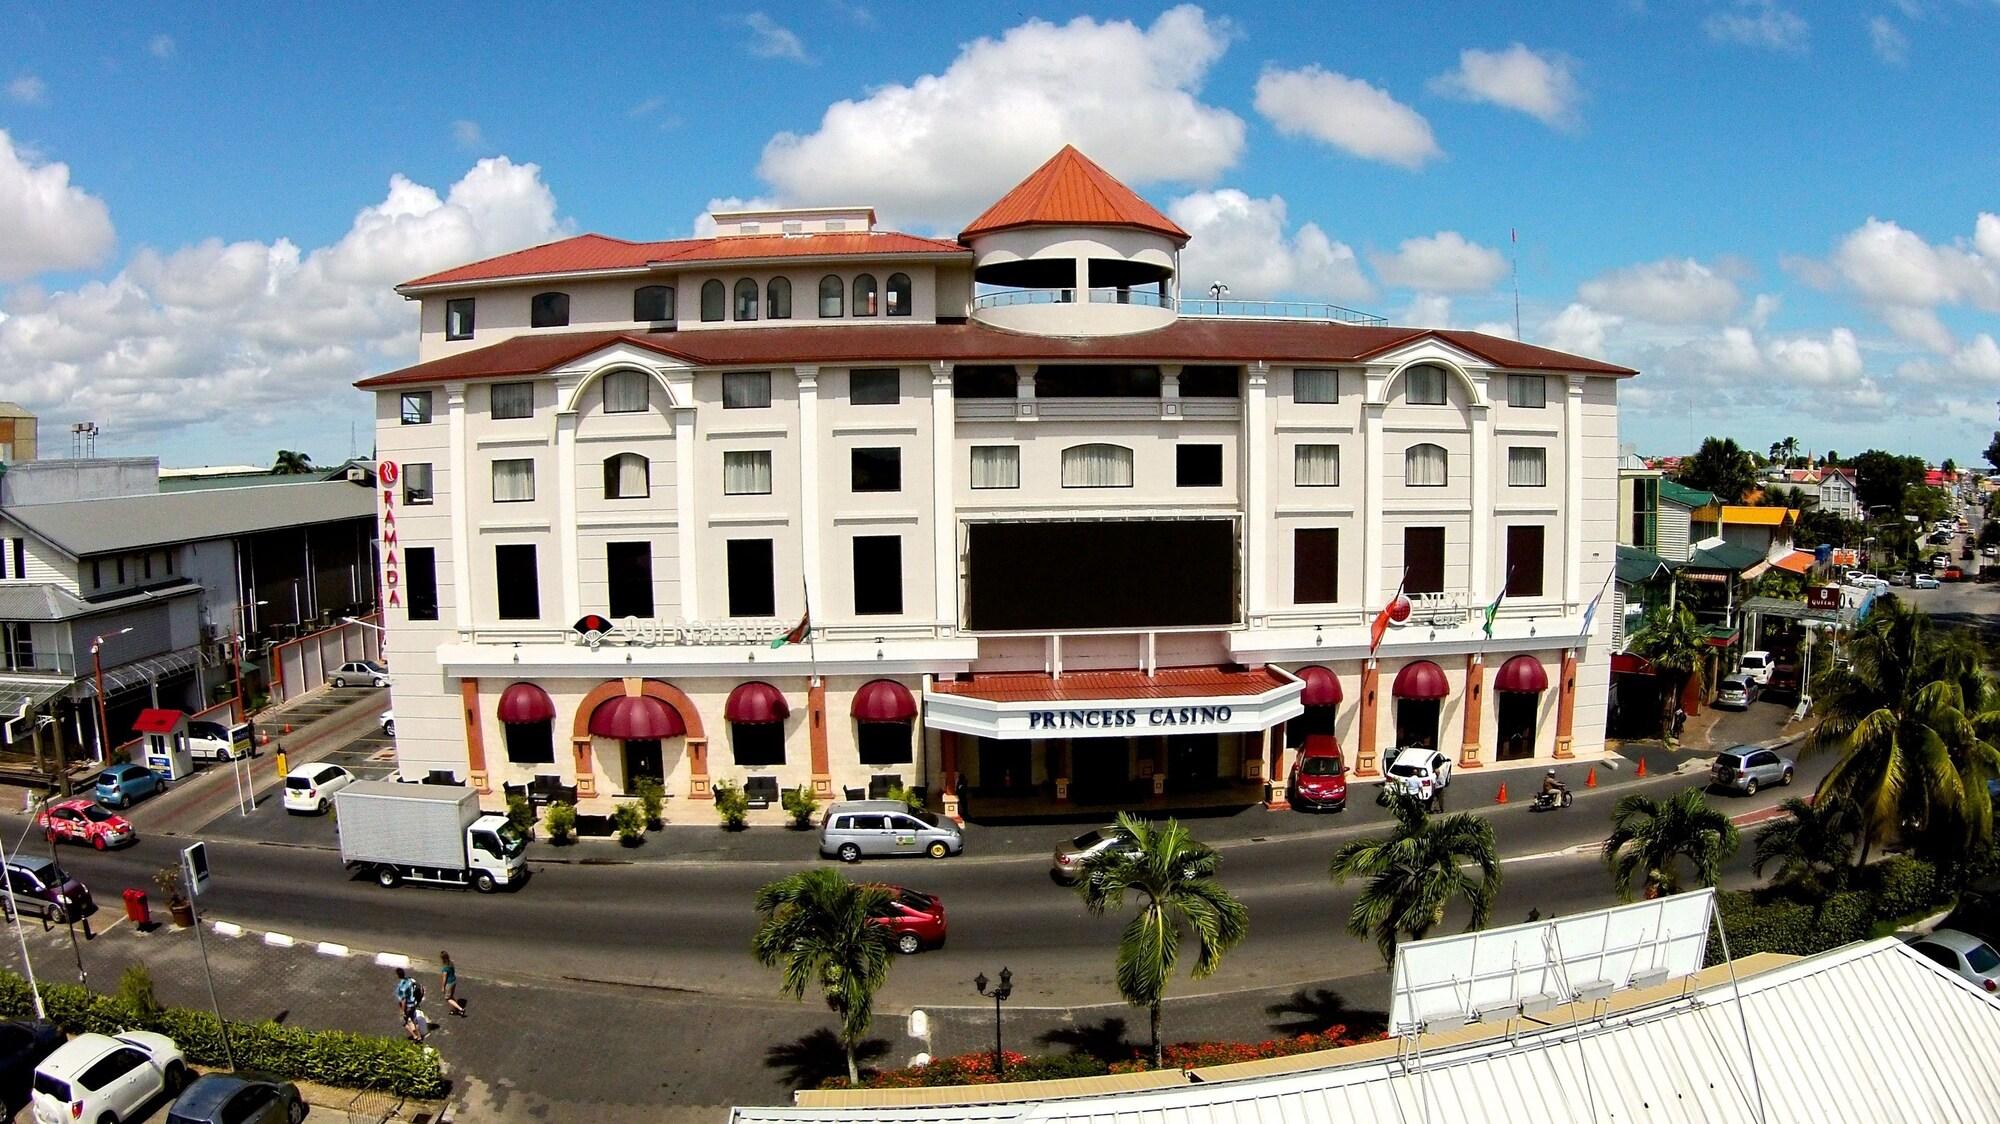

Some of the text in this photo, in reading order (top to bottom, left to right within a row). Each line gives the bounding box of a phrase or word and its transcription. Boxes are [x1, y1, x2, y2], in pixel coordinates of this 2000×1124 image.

[384, 490, 400, 609] RAMADA
[622, 615, 807, 643] Ogi Restauran
[1029, 704, 1233, 729] PRINCESS CASINO
